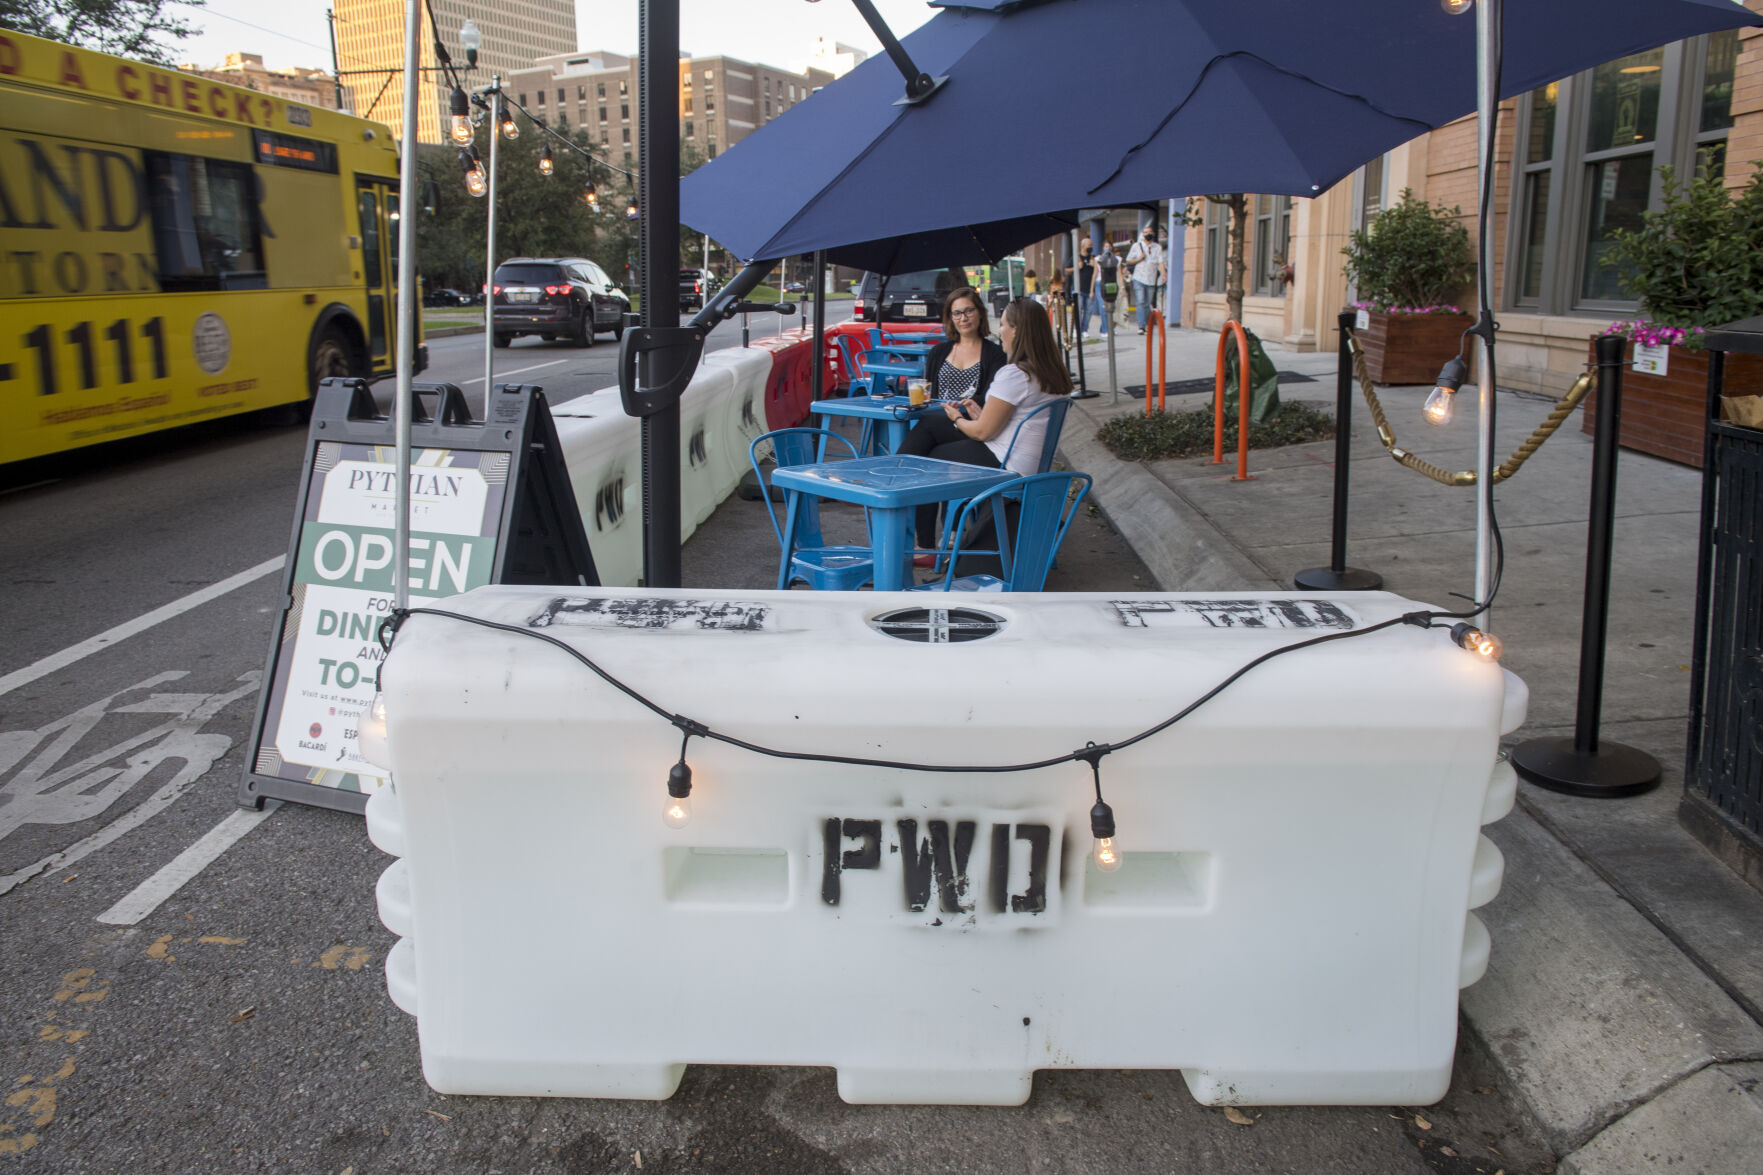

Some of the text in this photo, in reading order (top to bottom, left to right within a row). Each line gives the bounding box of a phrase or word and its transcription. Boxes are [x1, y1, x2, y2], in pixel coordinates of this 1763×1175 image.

[58, 51, 88, 91] A
[348, 469, 464, 497] PYTIAN
[370, 502, 430, 515] MAET
[313, 529, 473, 594] OPEN
[821, 816, 1051, 914] PWD
